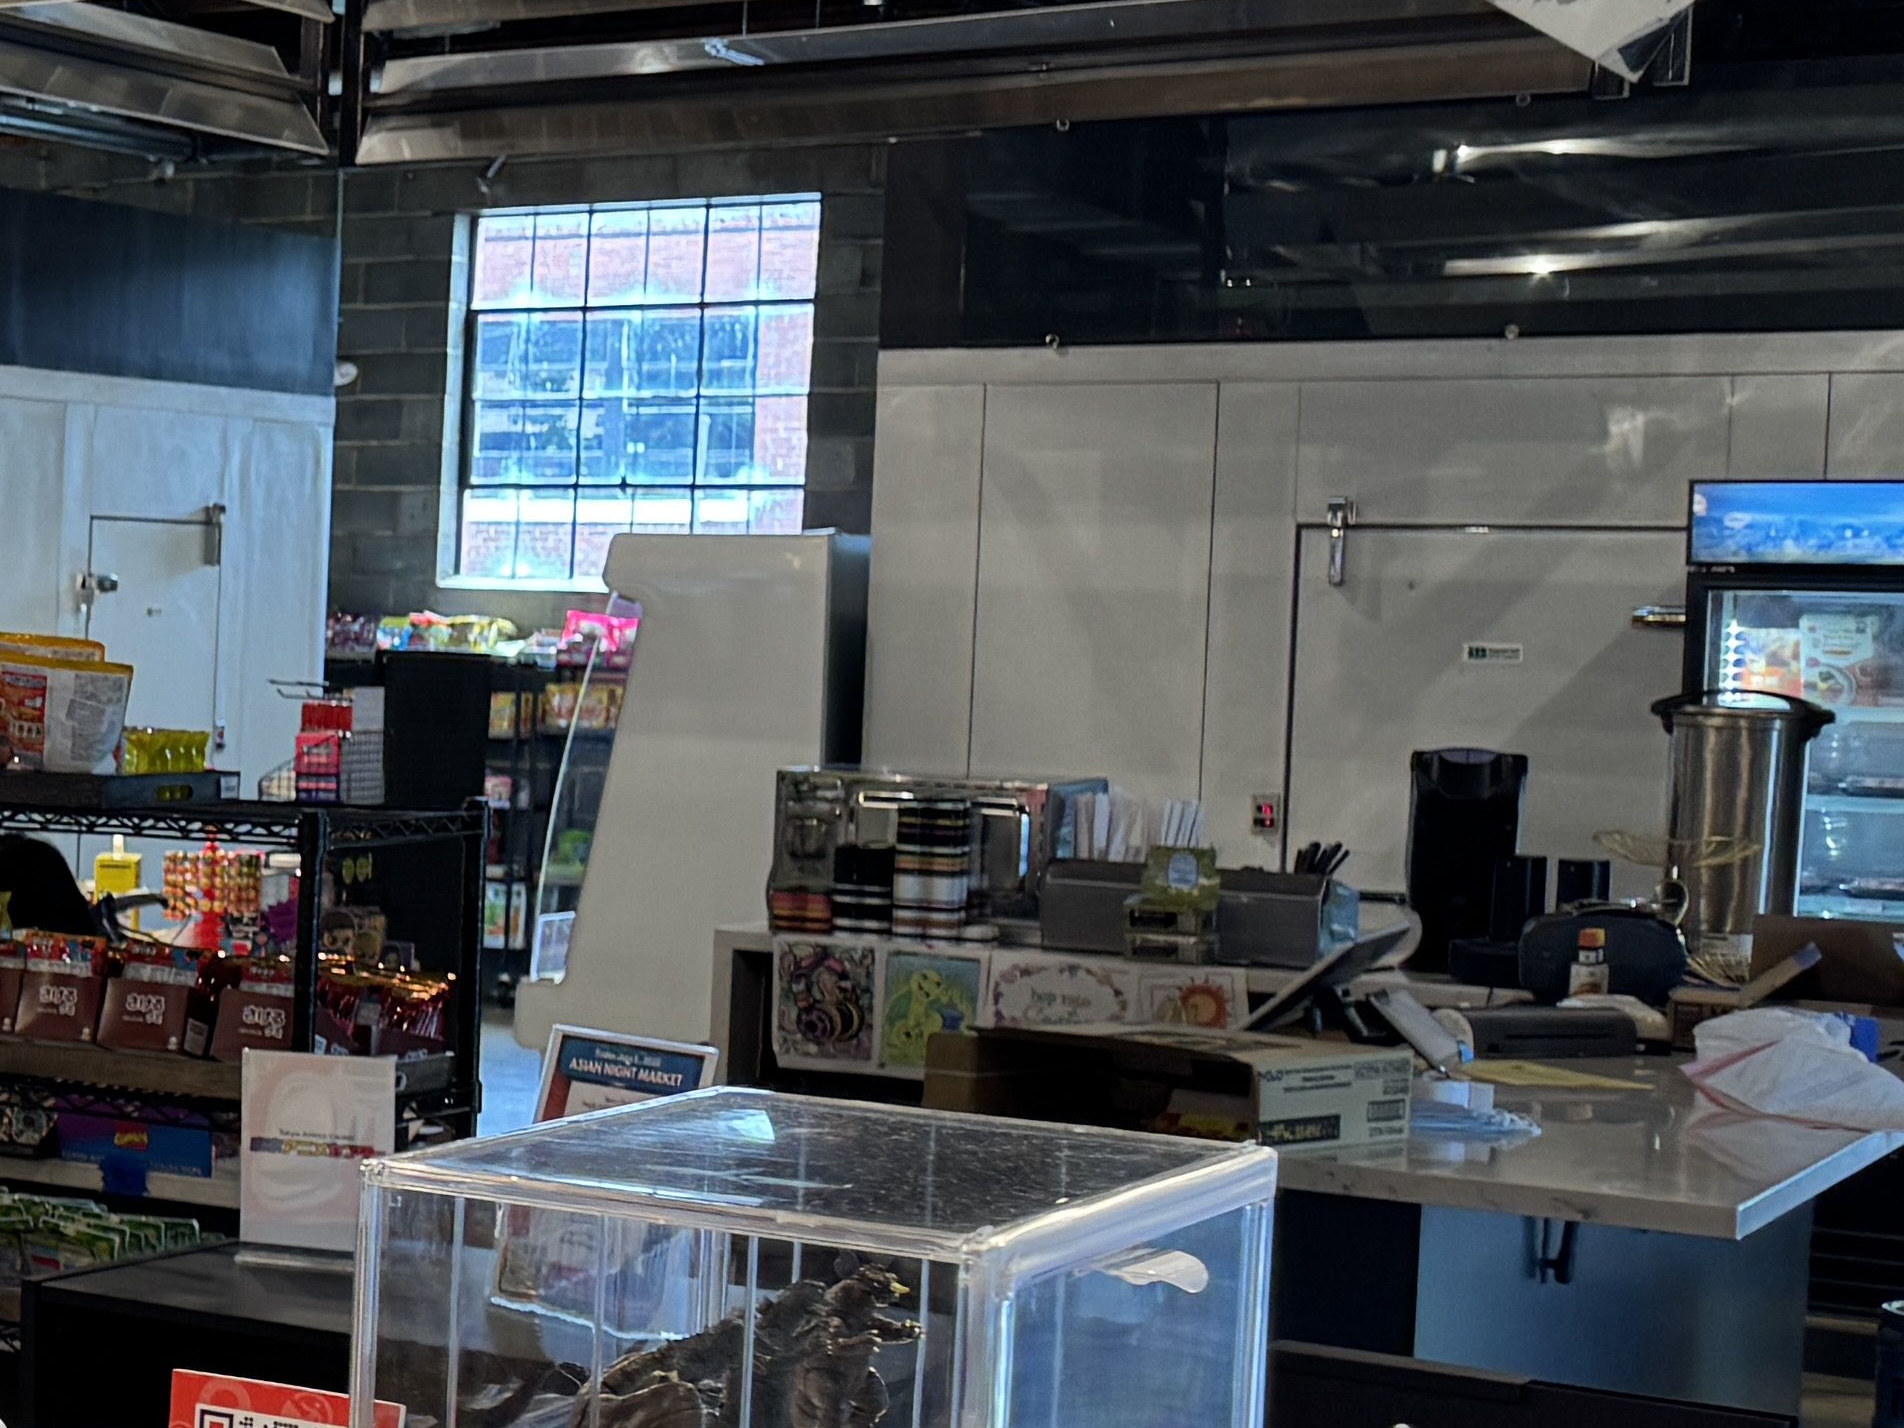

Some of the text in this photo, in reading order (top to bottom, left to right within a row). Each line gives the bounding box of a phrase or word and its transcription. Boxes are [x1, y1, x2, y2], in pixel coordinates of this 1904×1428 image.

[569, 1058, 602, 1074] ASIAN
[603, 1063, 637, 1080] NIGHT
[638, 1069, 682, 1087] MARKET
